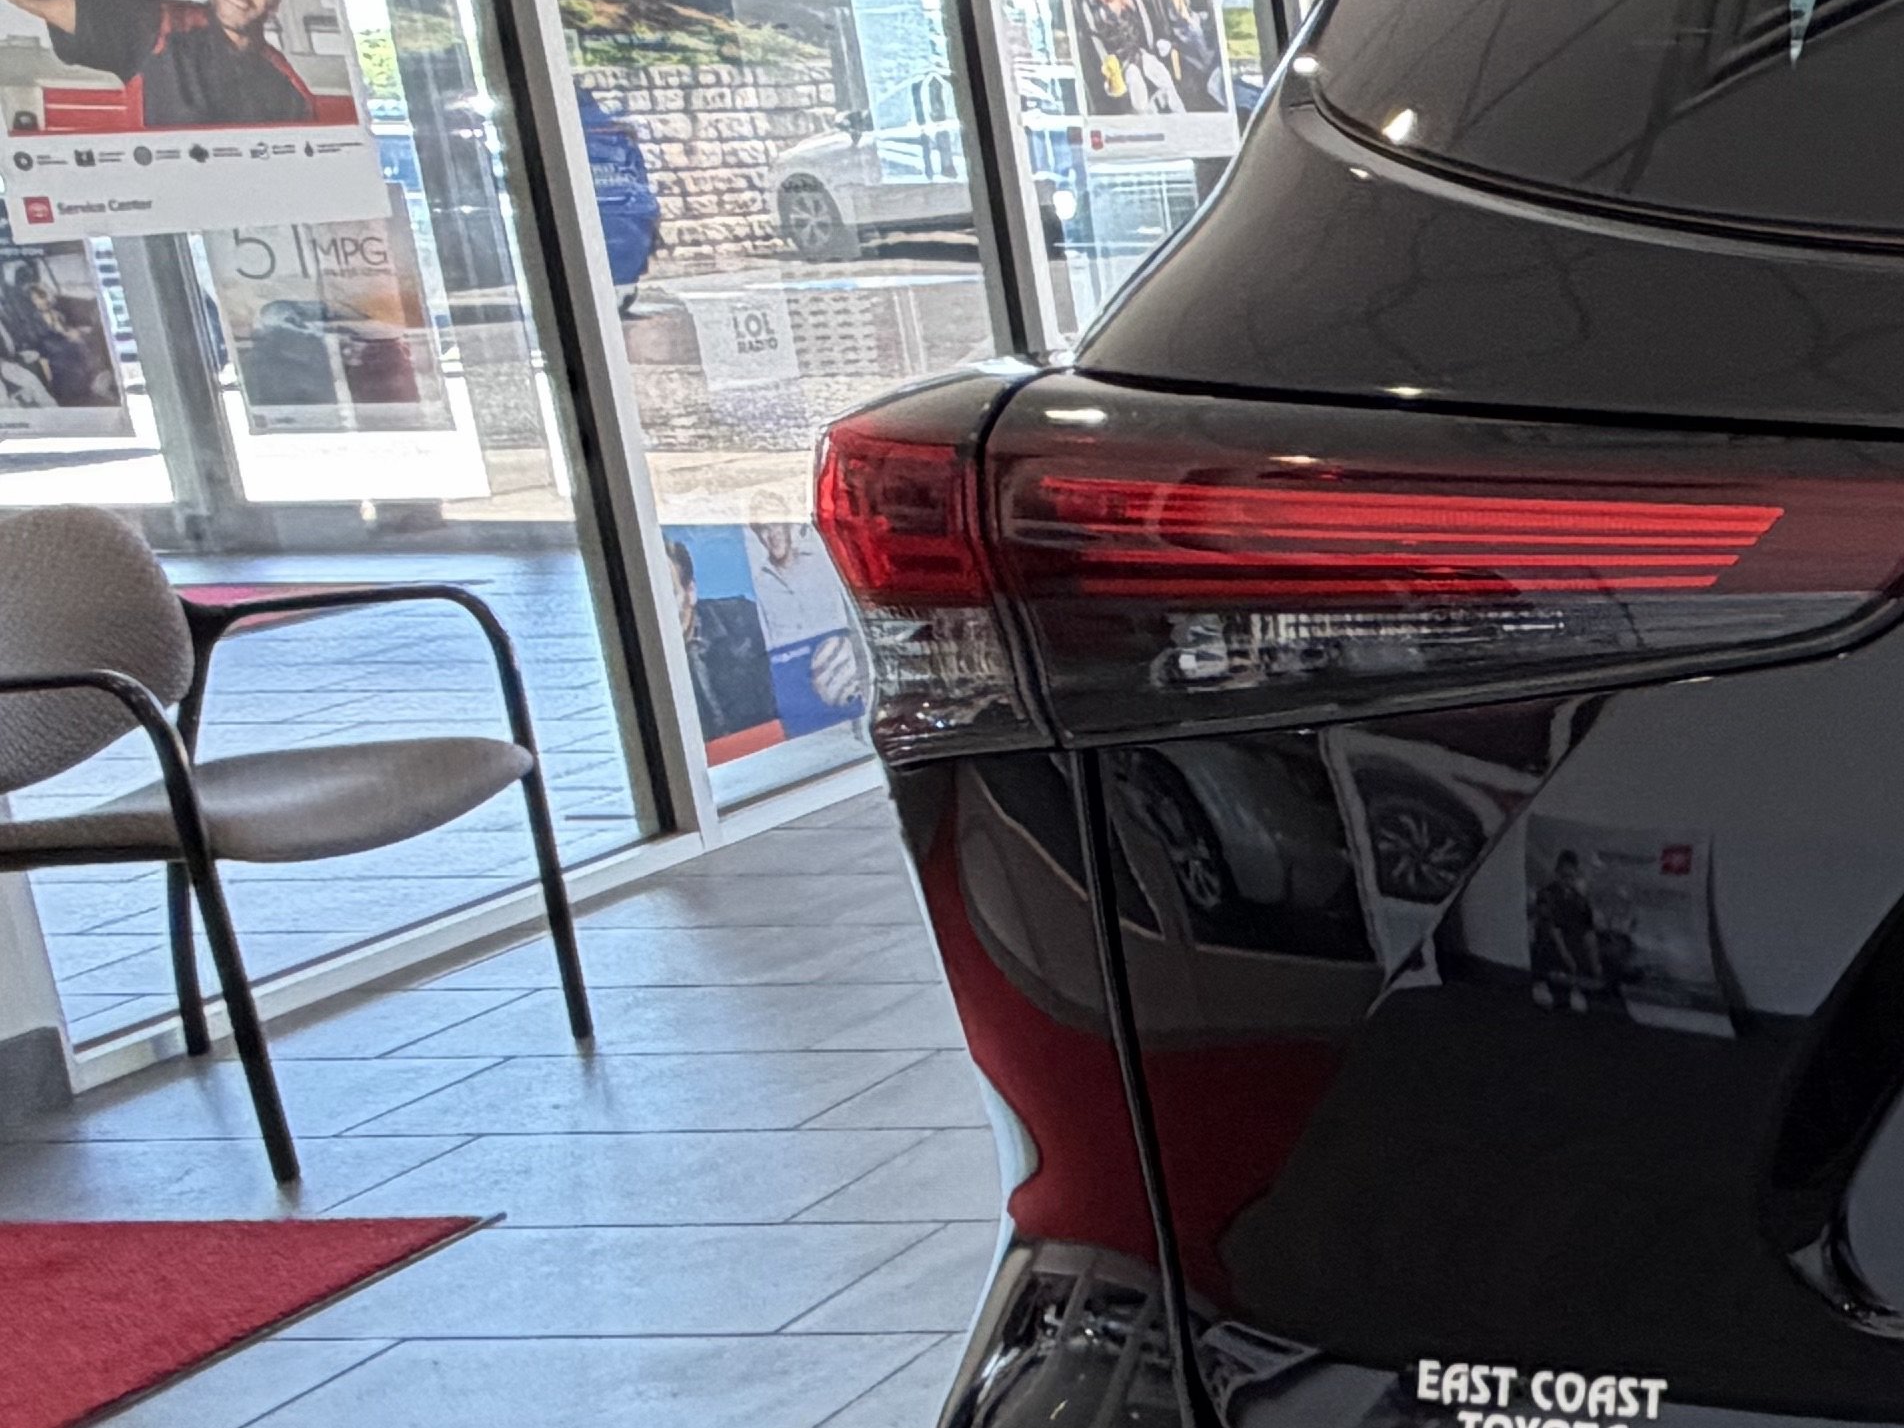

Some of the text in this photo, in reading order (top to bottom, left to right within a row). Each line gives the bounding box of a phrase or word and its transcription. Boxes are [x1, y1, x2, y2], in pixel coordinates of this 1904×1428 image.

[313, 235, 389, 267] MPG
[732, 312, 775, 339] LOL
[1416, 1359, 1669, 1420] EAST COAST
